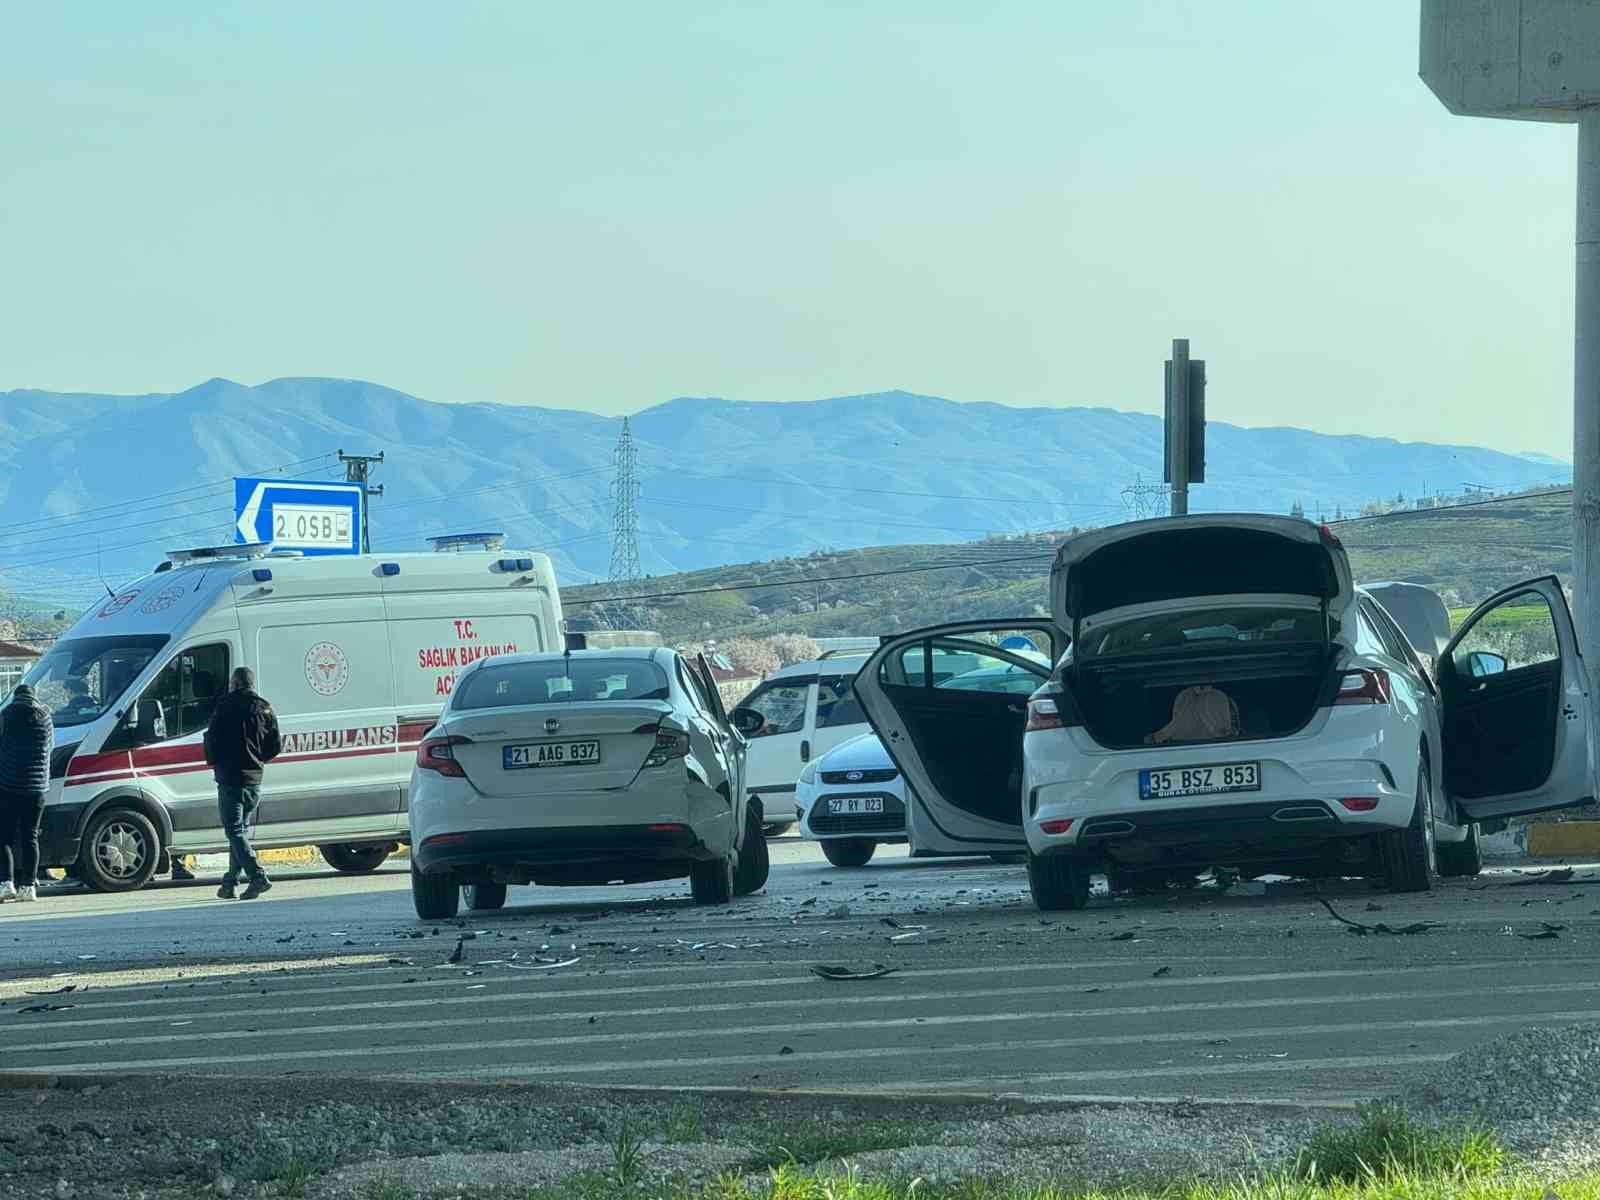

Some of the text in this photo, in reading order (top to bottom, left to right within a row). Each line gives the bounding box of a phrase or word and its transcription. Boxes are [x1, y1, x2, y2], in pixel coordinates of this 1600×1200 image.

[276, 515, 331, 538] 2. OSB
[454, 620, 478, 639] T.C.
[283, 726, 394, 753] AMBULANS
[513, 743, 595, 763] 21 AAG 837
[1151, 772, 1171, 791] 35
[1181, 769, 1213, 788] BSZ
[1223, 766, 1255, 785] 853
